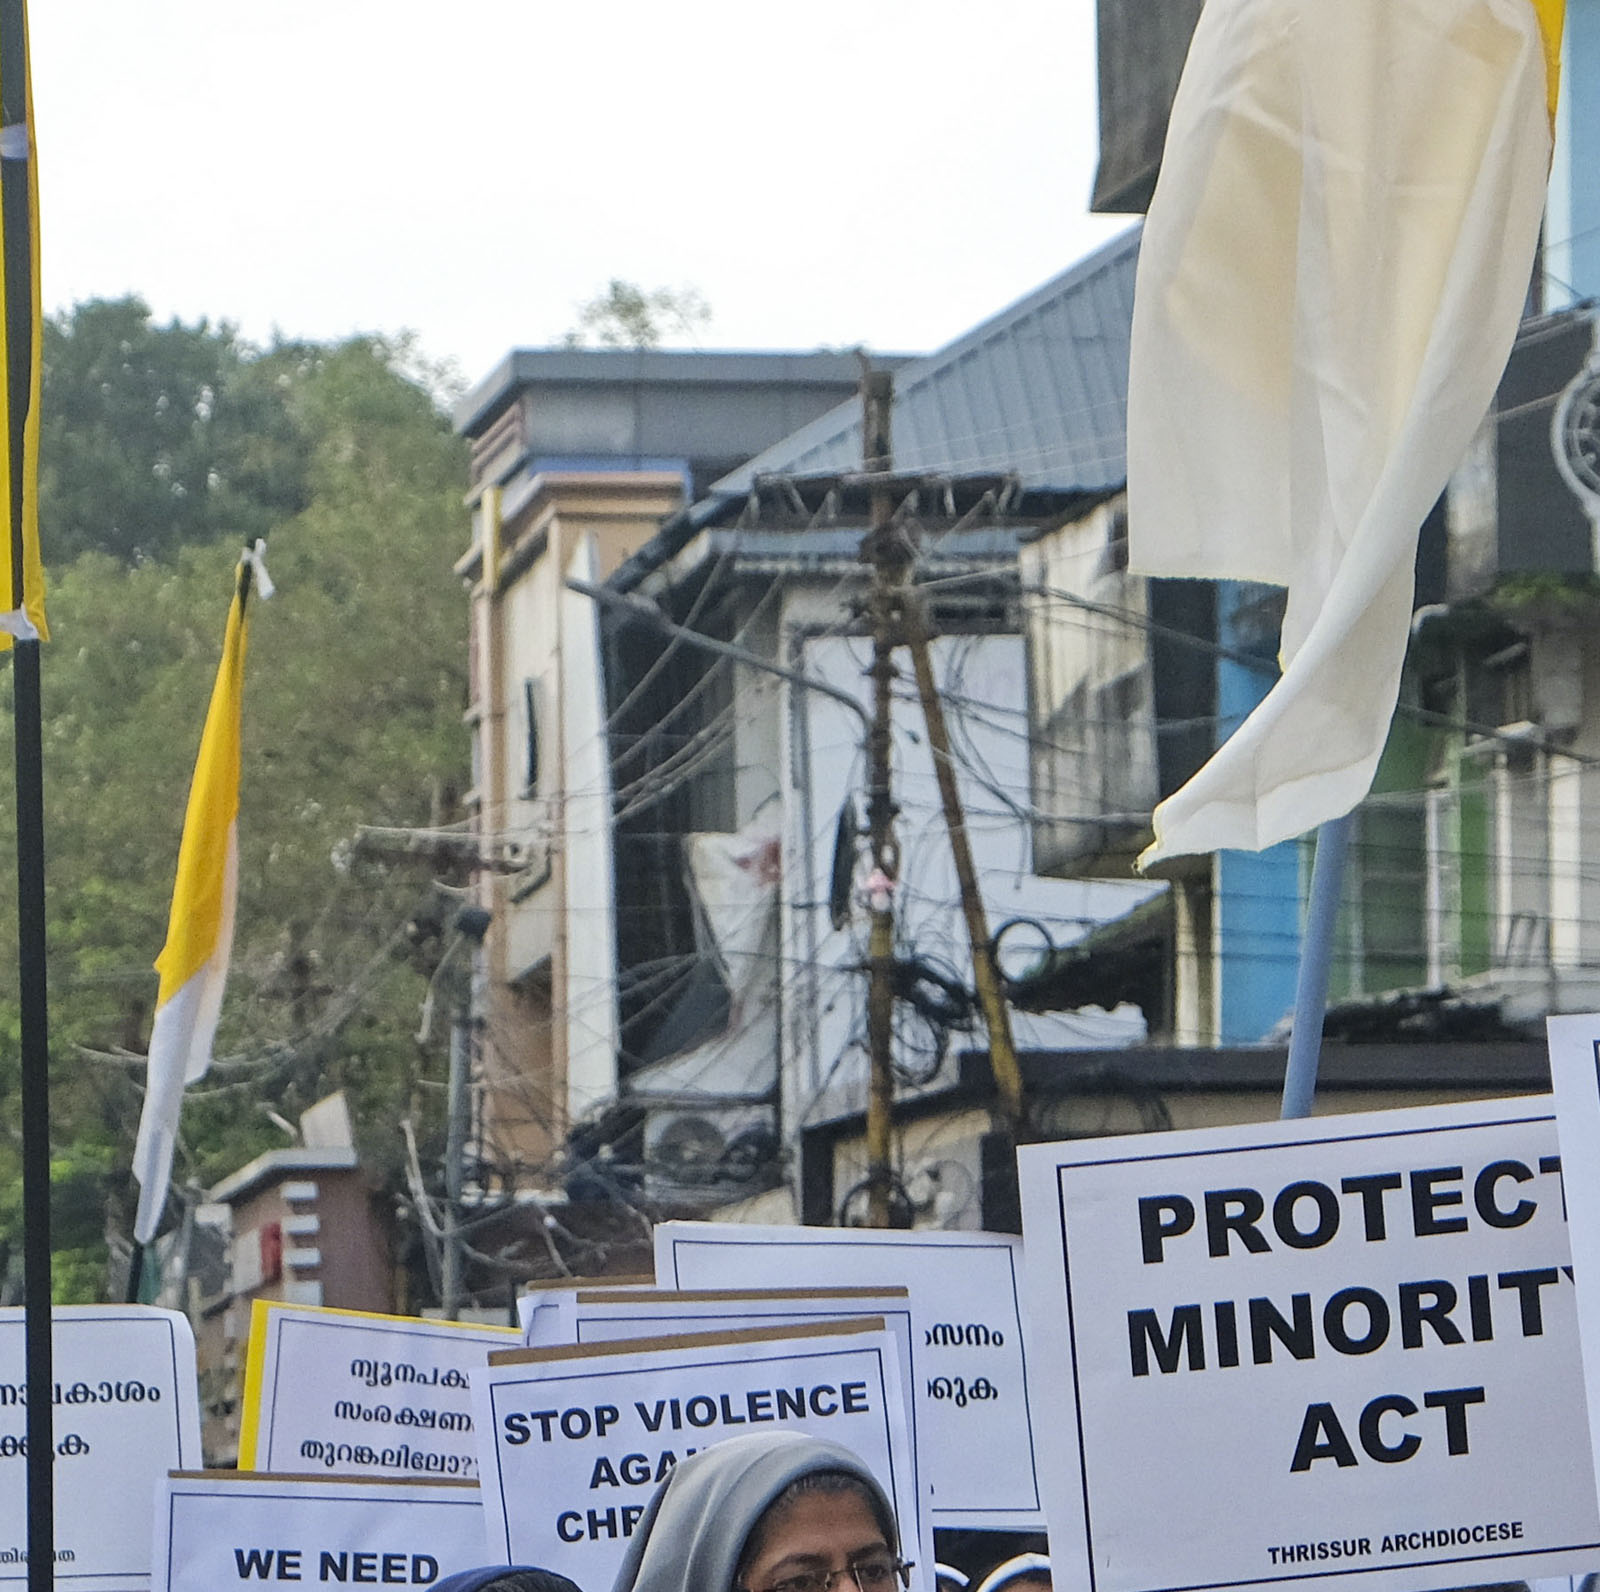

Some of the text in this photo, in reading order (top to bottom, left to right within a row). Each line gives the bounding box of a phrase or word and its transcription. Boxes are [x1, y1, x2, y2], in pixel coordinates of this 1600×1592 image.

[1127, 1266, 1576, 1377] MINORIT
[334, 1399, 475, 1433] സംരക്ഷണ
[504, 1404, 620, 1446] STOP
[634, 1381, 870, 1433] VIOLENCE
[1289, 1386, 1486, 1473] ACT
[300, 1438, 479, 1478] തുറങ്കലിലോ?
[1268, 1521, 1524, 1565] THRISSUR ARCHDIOCESE
[234, 1549, 440, 1584] WE NEED
